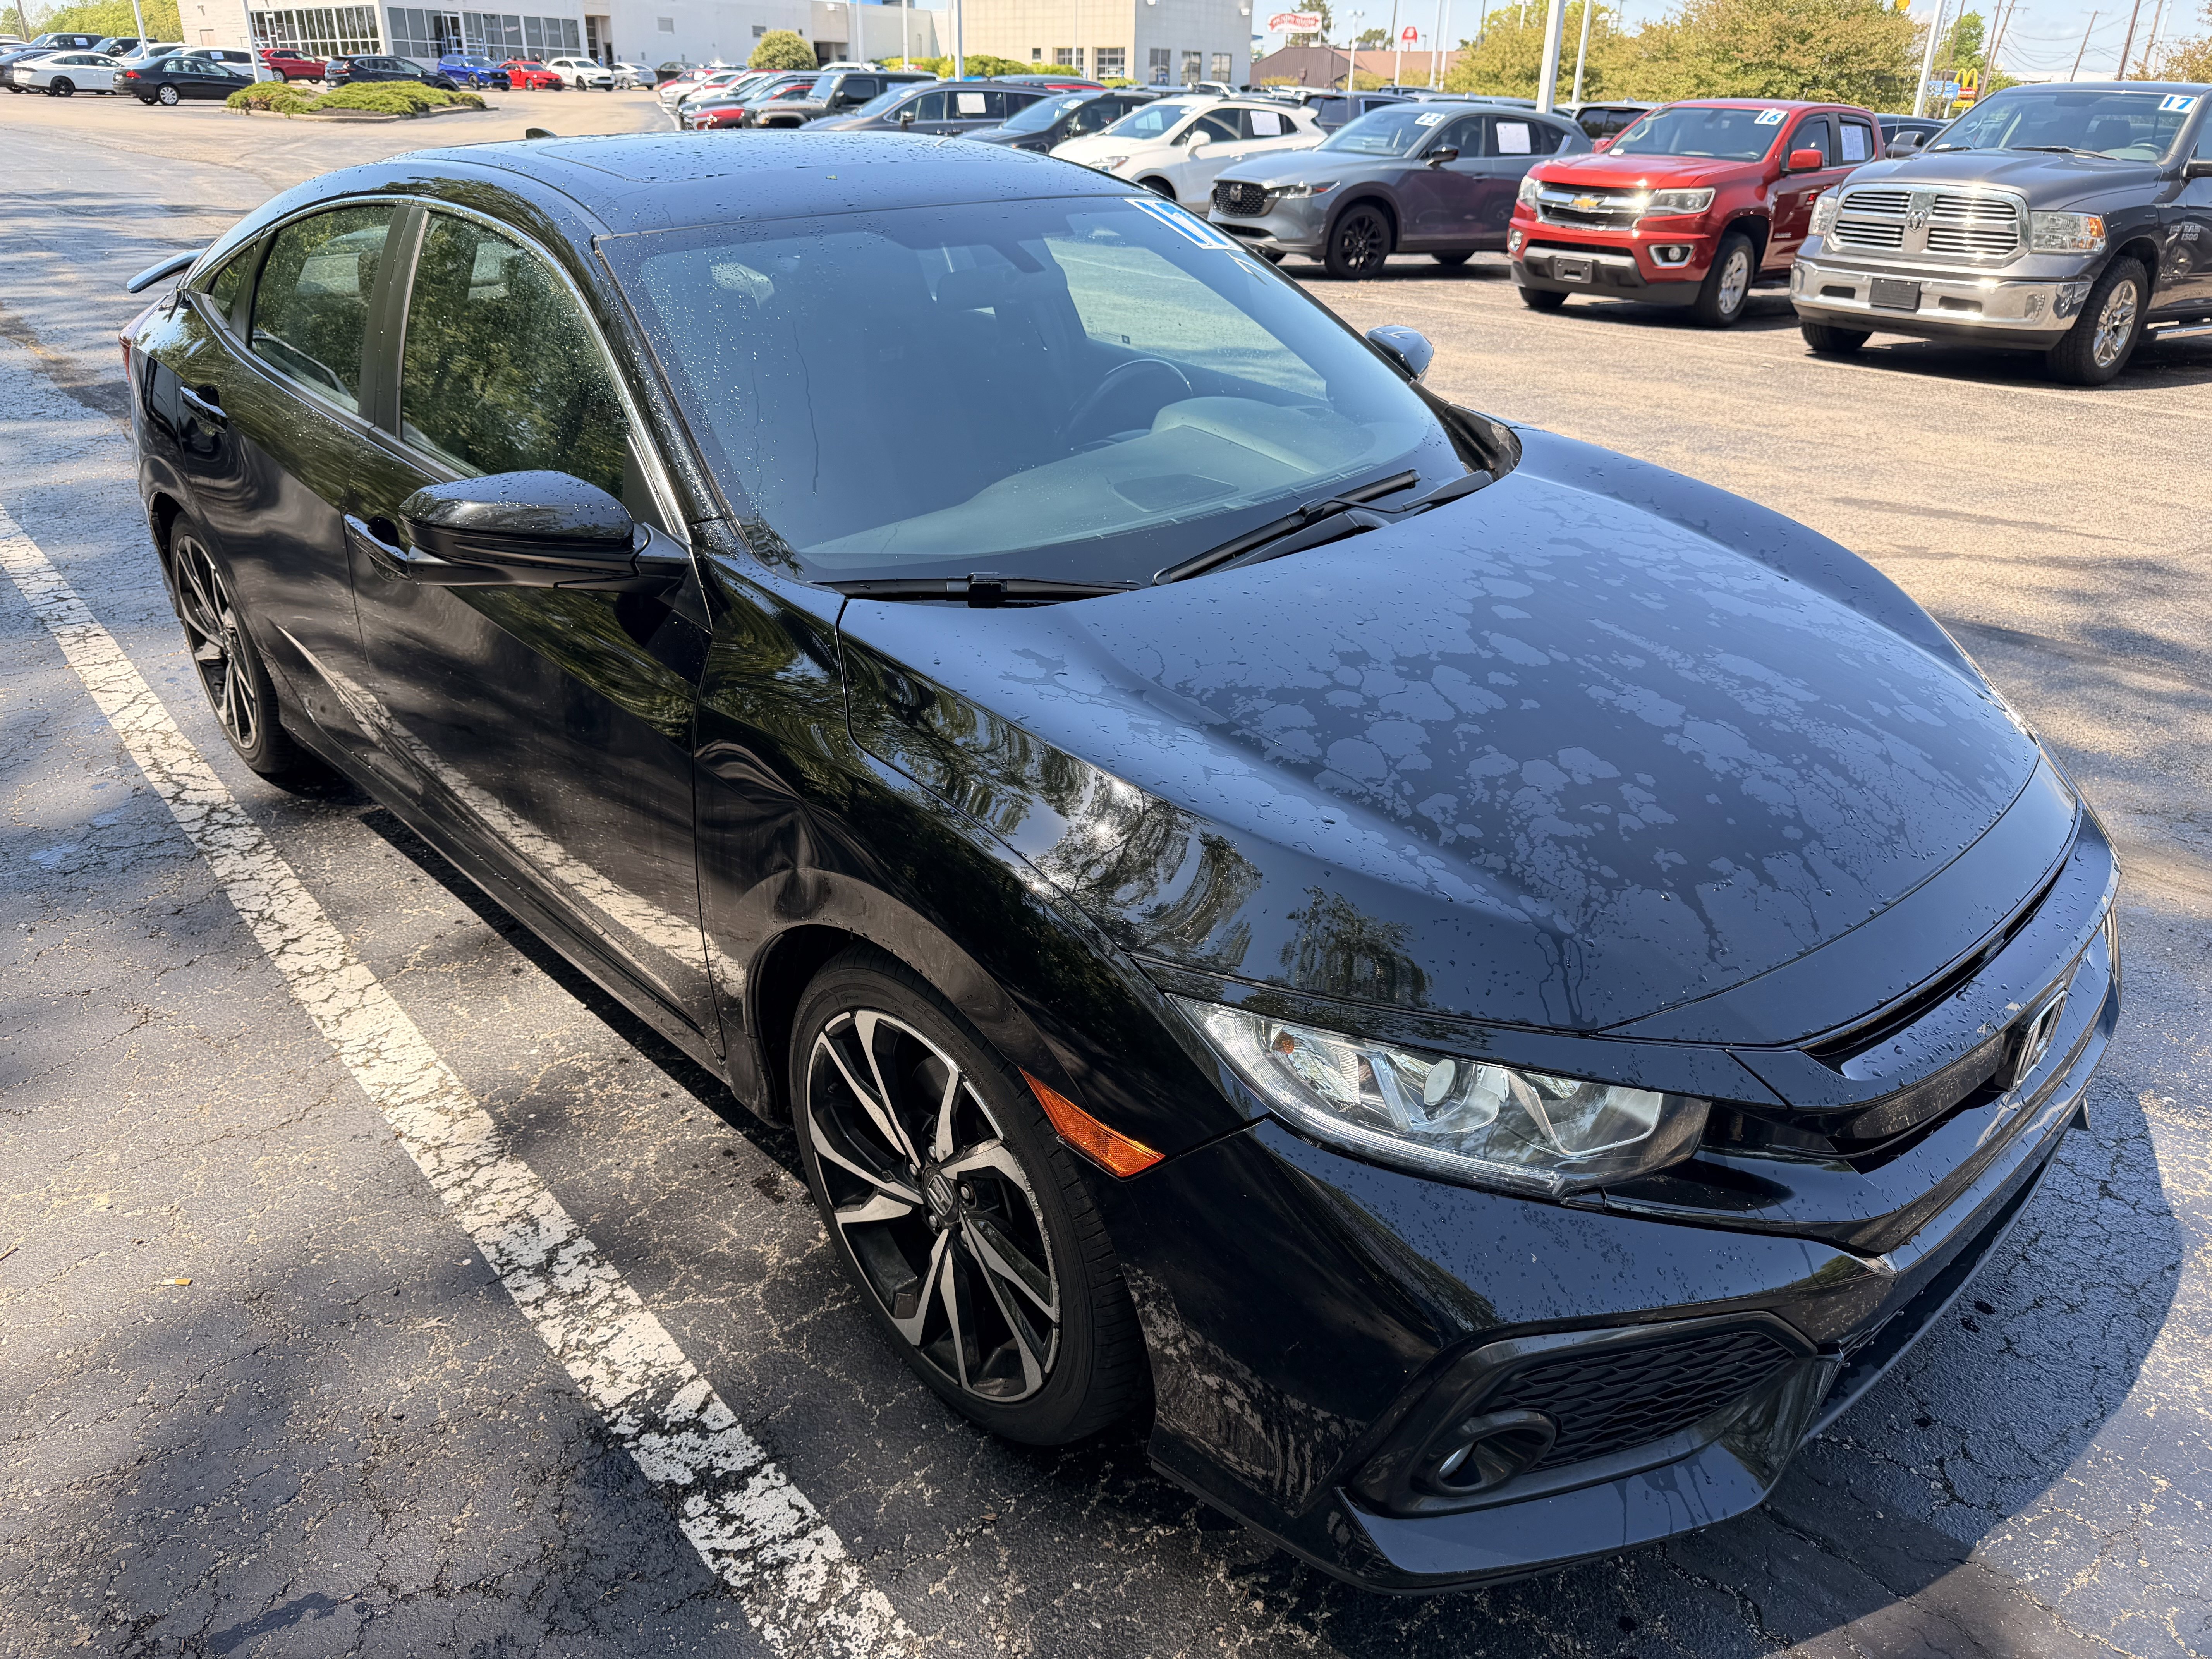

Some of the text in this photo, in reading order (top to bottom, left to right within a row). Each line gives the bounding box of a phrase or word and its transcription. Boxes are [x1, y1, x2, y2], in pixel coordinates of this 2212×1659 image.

[2163, 96, 2195, 109] 17
[1759, 111, 1782, 122] 16
[1134, 201, 1228, 246] 17
[2181, 233, 2199, 241] 1500
